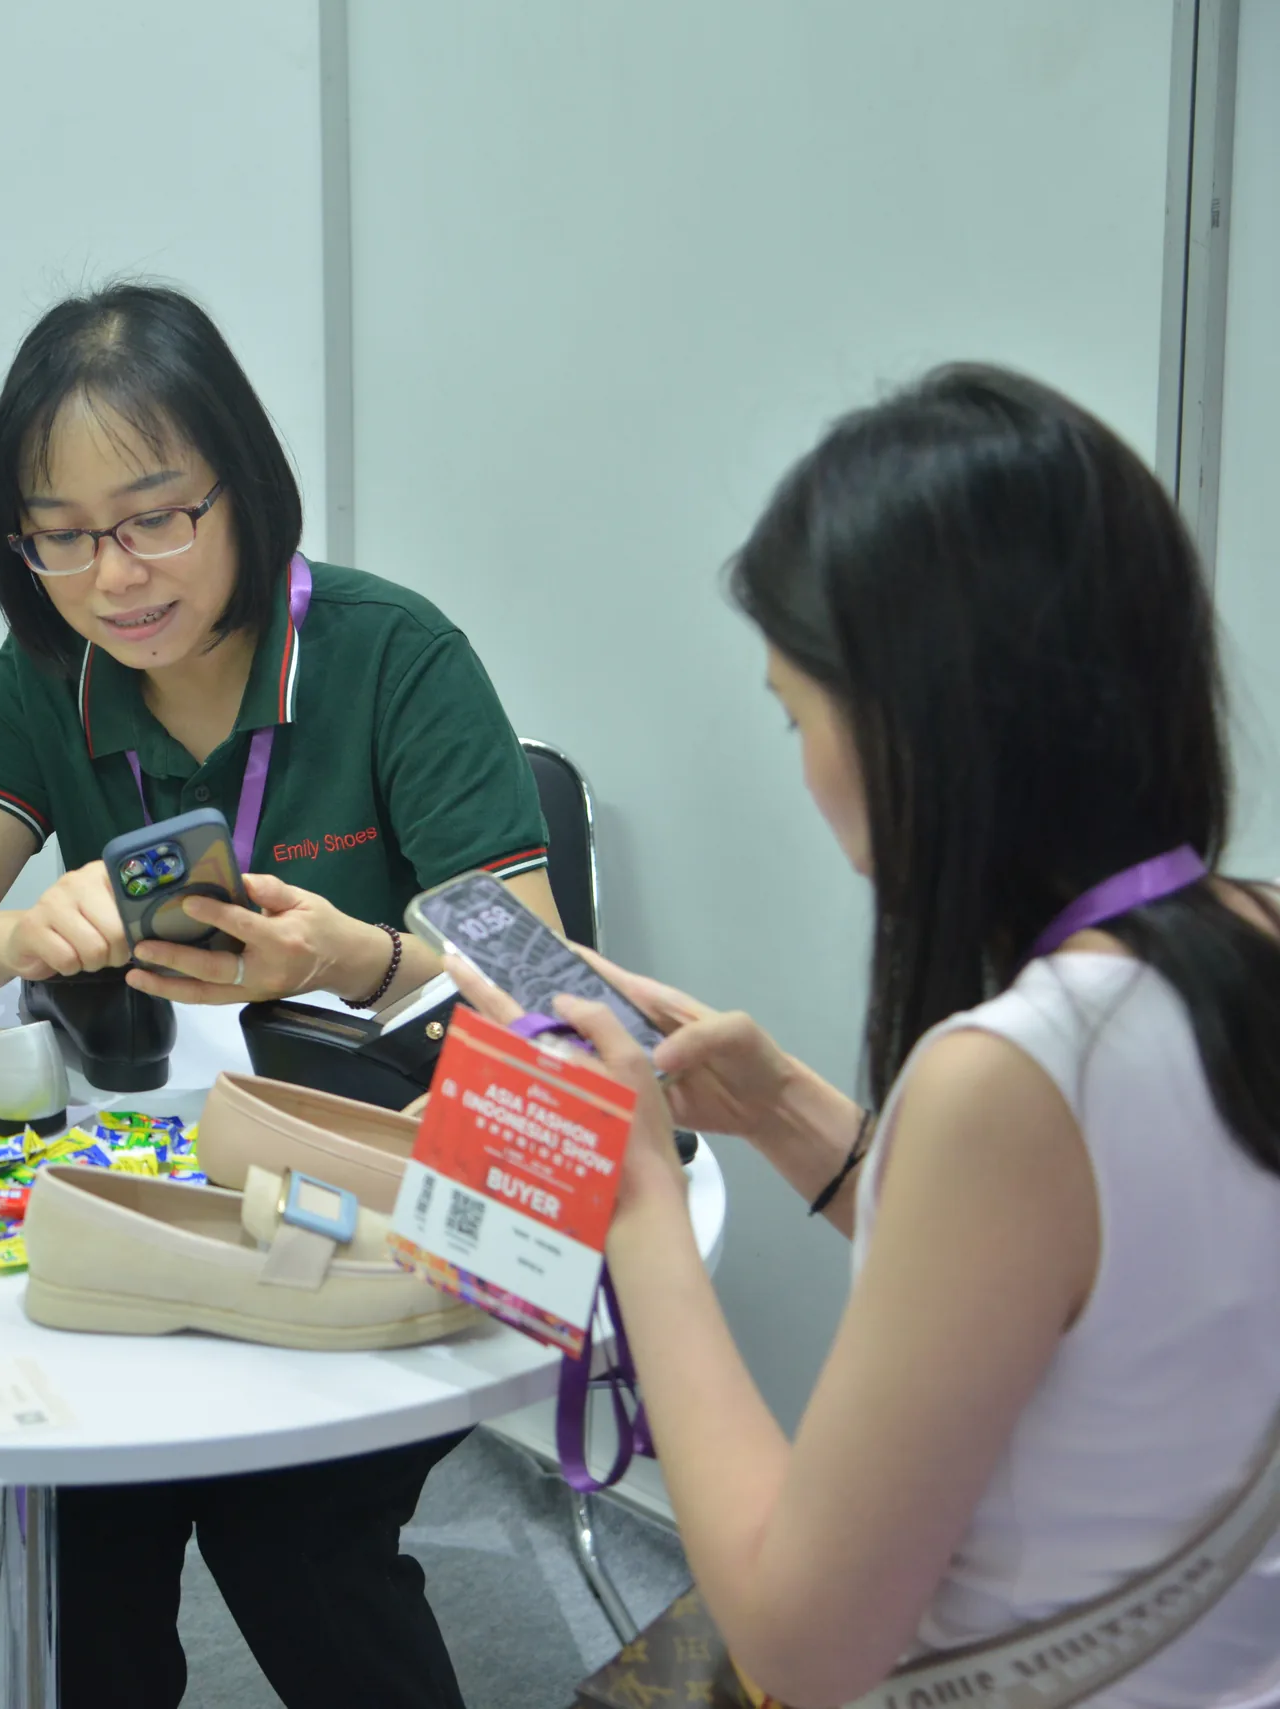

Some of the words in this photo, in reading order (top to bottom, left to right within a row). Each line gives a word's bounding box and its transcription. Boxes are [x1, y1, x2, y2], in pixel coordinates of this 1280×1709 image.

[273, 838, 319, 862] Emily
[324, 826, 377, 852] Shoes
[485, 1083, 523, 1112] ASIA
[526, 1102, 598, 1149] FASHION
[561, 1138, 616, 1176] SHOW
[486, 1166, 561, 1221] BUYER
